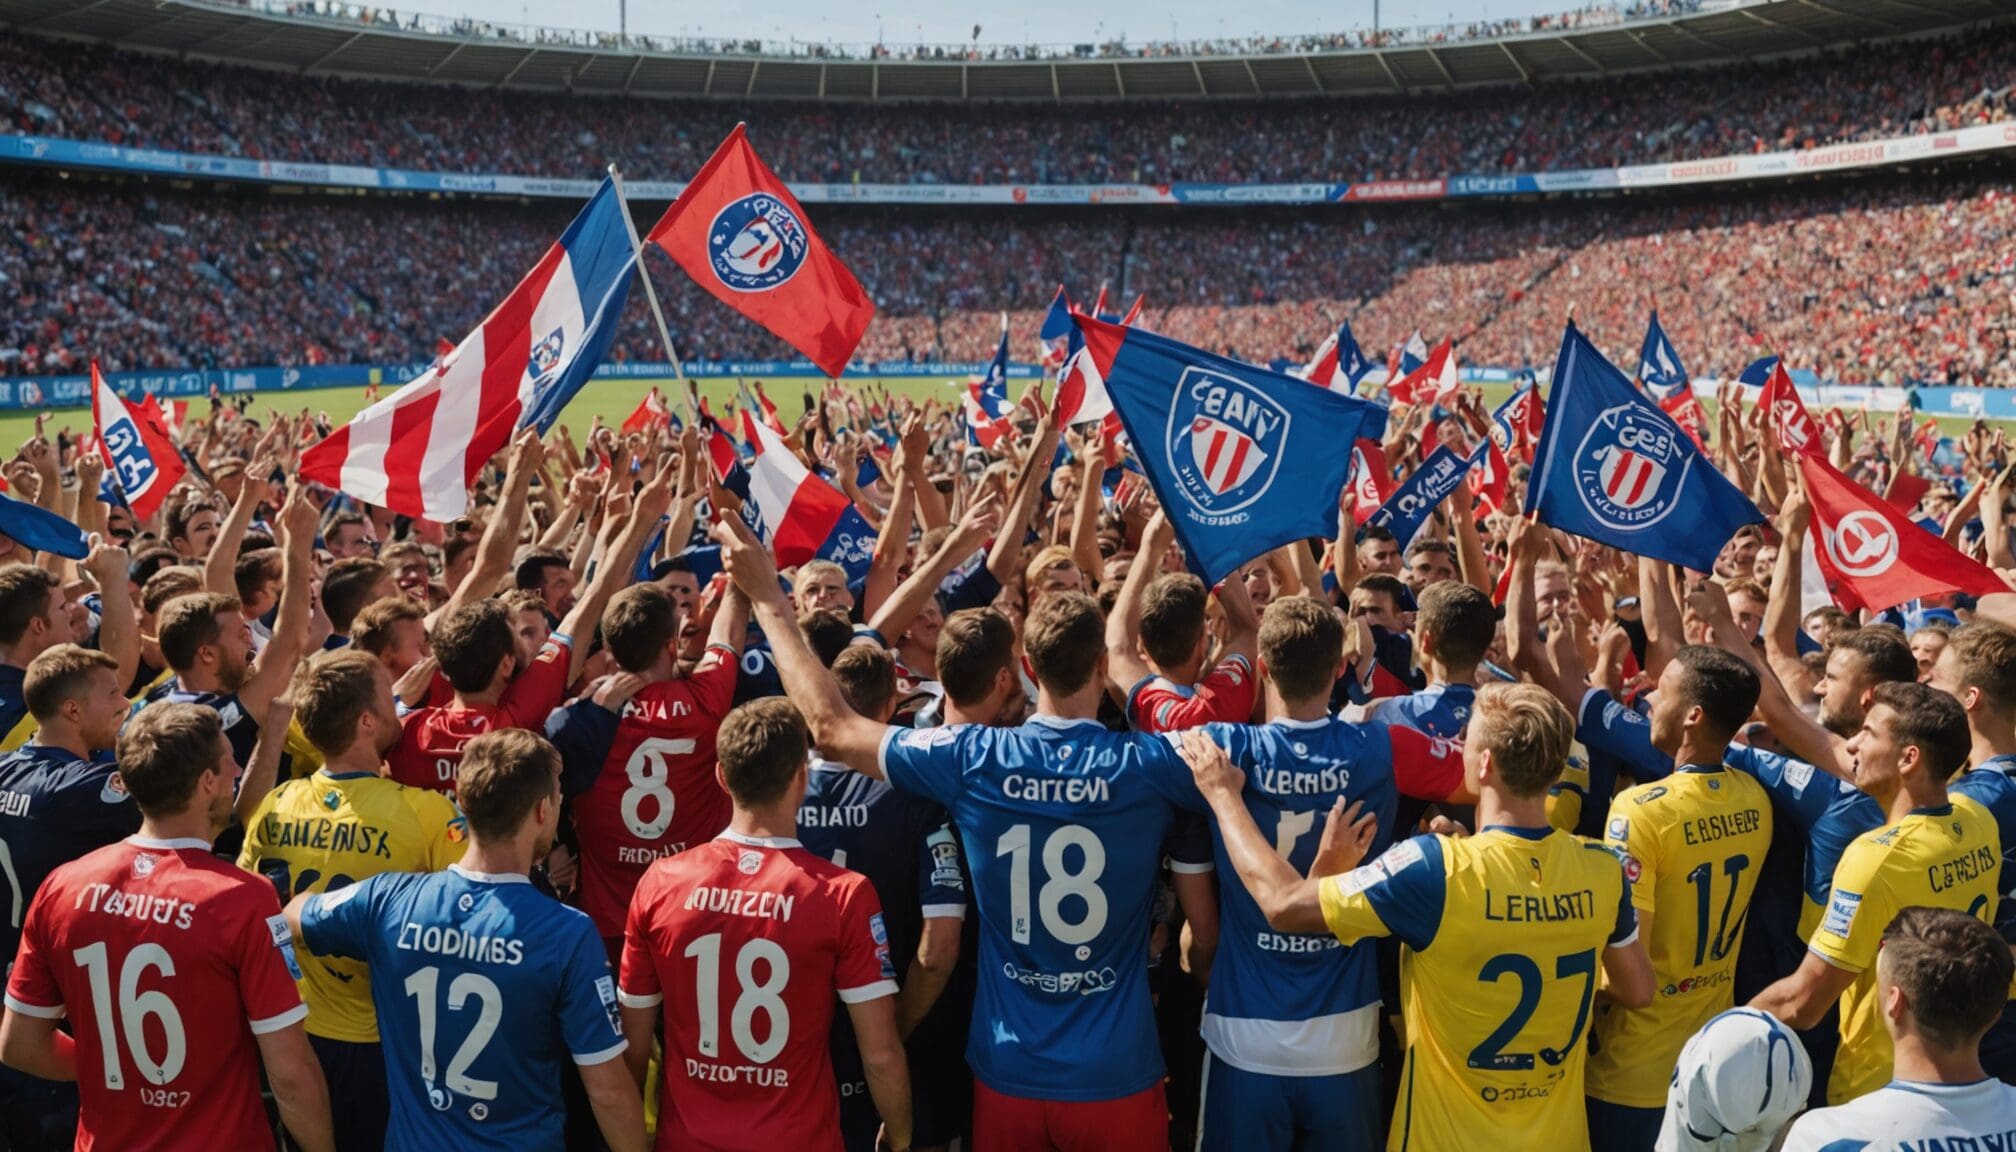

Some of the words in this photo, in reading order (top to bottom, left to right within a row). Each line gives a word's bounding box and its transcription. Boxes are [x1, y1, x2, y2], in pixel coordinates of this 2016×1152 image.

[996, 824, 1109, 945] 18
[73, 941, 187, 1091] 16
[404, 966, 503, 1100] 12
[684, 932, 790, 1064] 18
[1467, 946, 1597, 1071] 27
